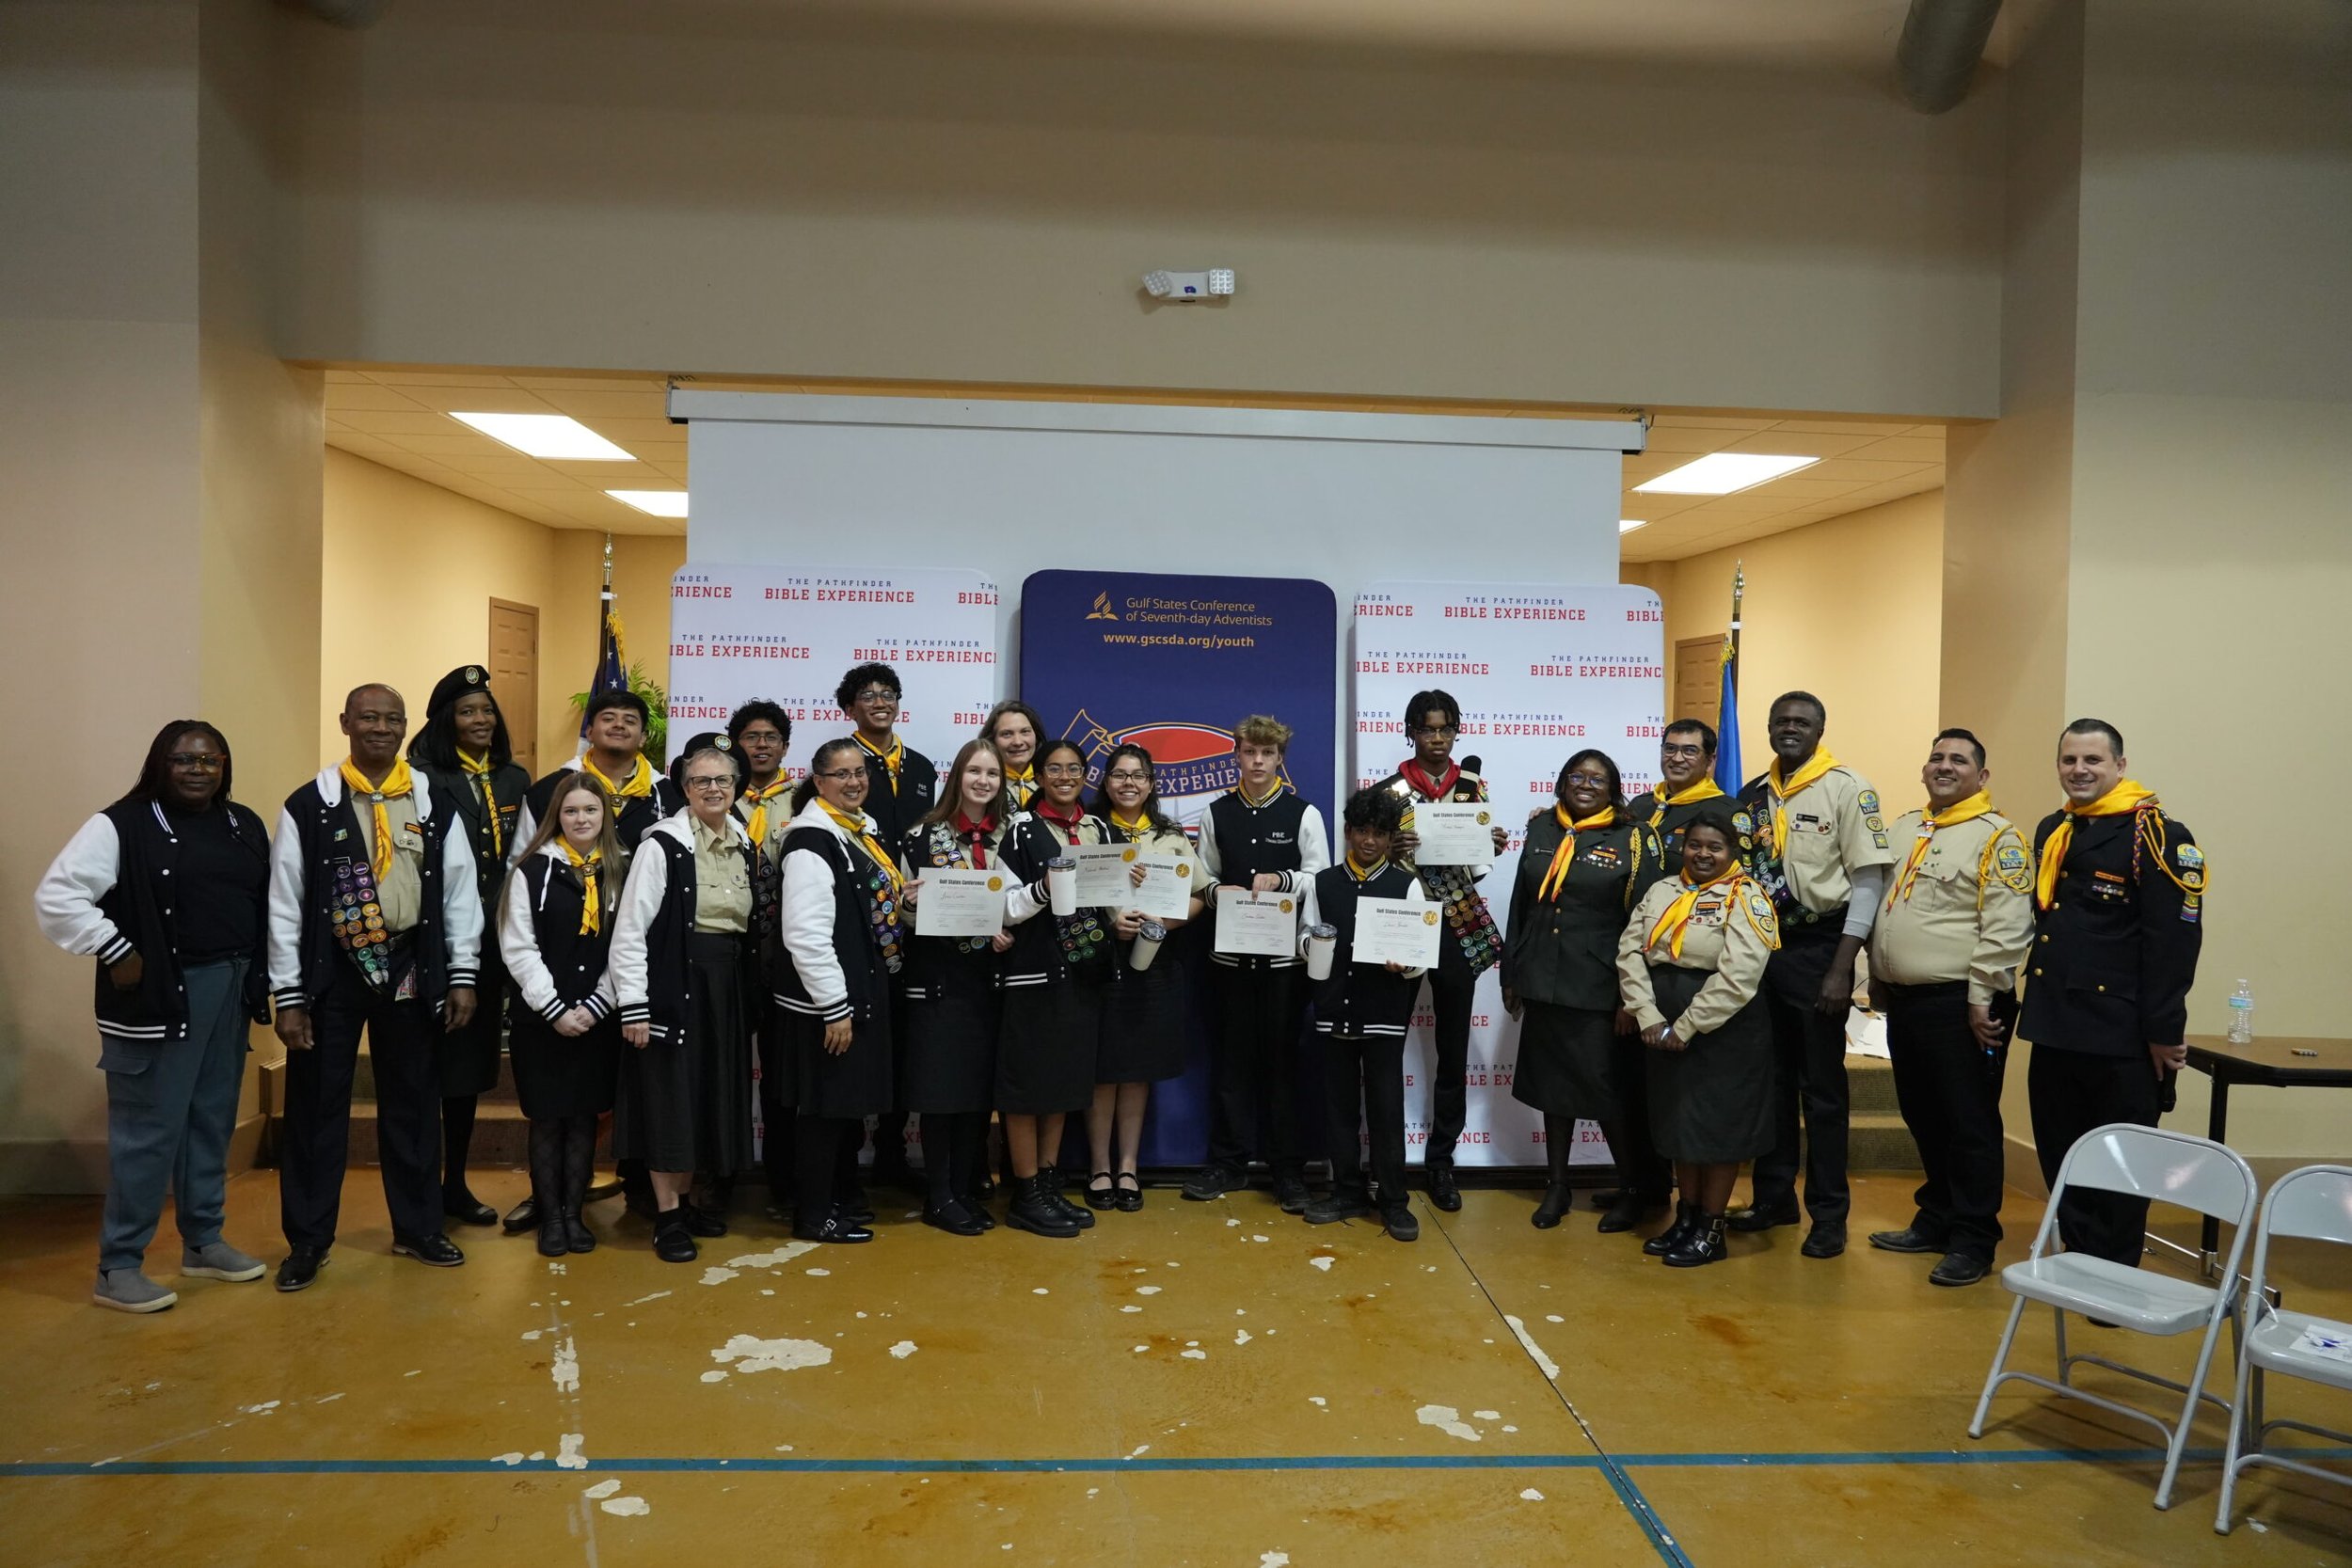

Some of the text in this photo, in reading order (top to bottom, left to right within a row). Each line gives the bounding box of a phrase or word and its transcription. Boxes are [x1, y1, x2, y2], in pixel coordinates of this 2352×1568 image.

[817, 578, 893, 588] PATHFINDER
[671, 586, 732, 598] RIENCE
[765, 588, 914, 603] BIBLE EXPERIENCE
[1126, 597, 1255, 612] Gulf States Conference
[1493, 597, 1564, 606] PATHFINDER
[1125, 611, 1273, 626] of Seventh-day Adventists
[1444, 607, 1586, 621] BIBLE EXPERIENCE
[711, 635, 787, 643] PATHFINDER
[1104, 633, 1255, 649] www.gscsda.org/youth
[711, 645, 810, 659] EXPERIENCE
[853, 649, 898, 661] BIBLE
[1396, 662, 1489, 674] EXPERIENCE
[1531, 665, 1663, 678] BIBLE EXPERIENC
[668, 706, 727, 719] RIENCE
[954, 713, 986, 724] BIBL
[1493, 713, 1564, 721] PATHFINDER
[1494, 723, 1585, 736] EXPERIENCE
